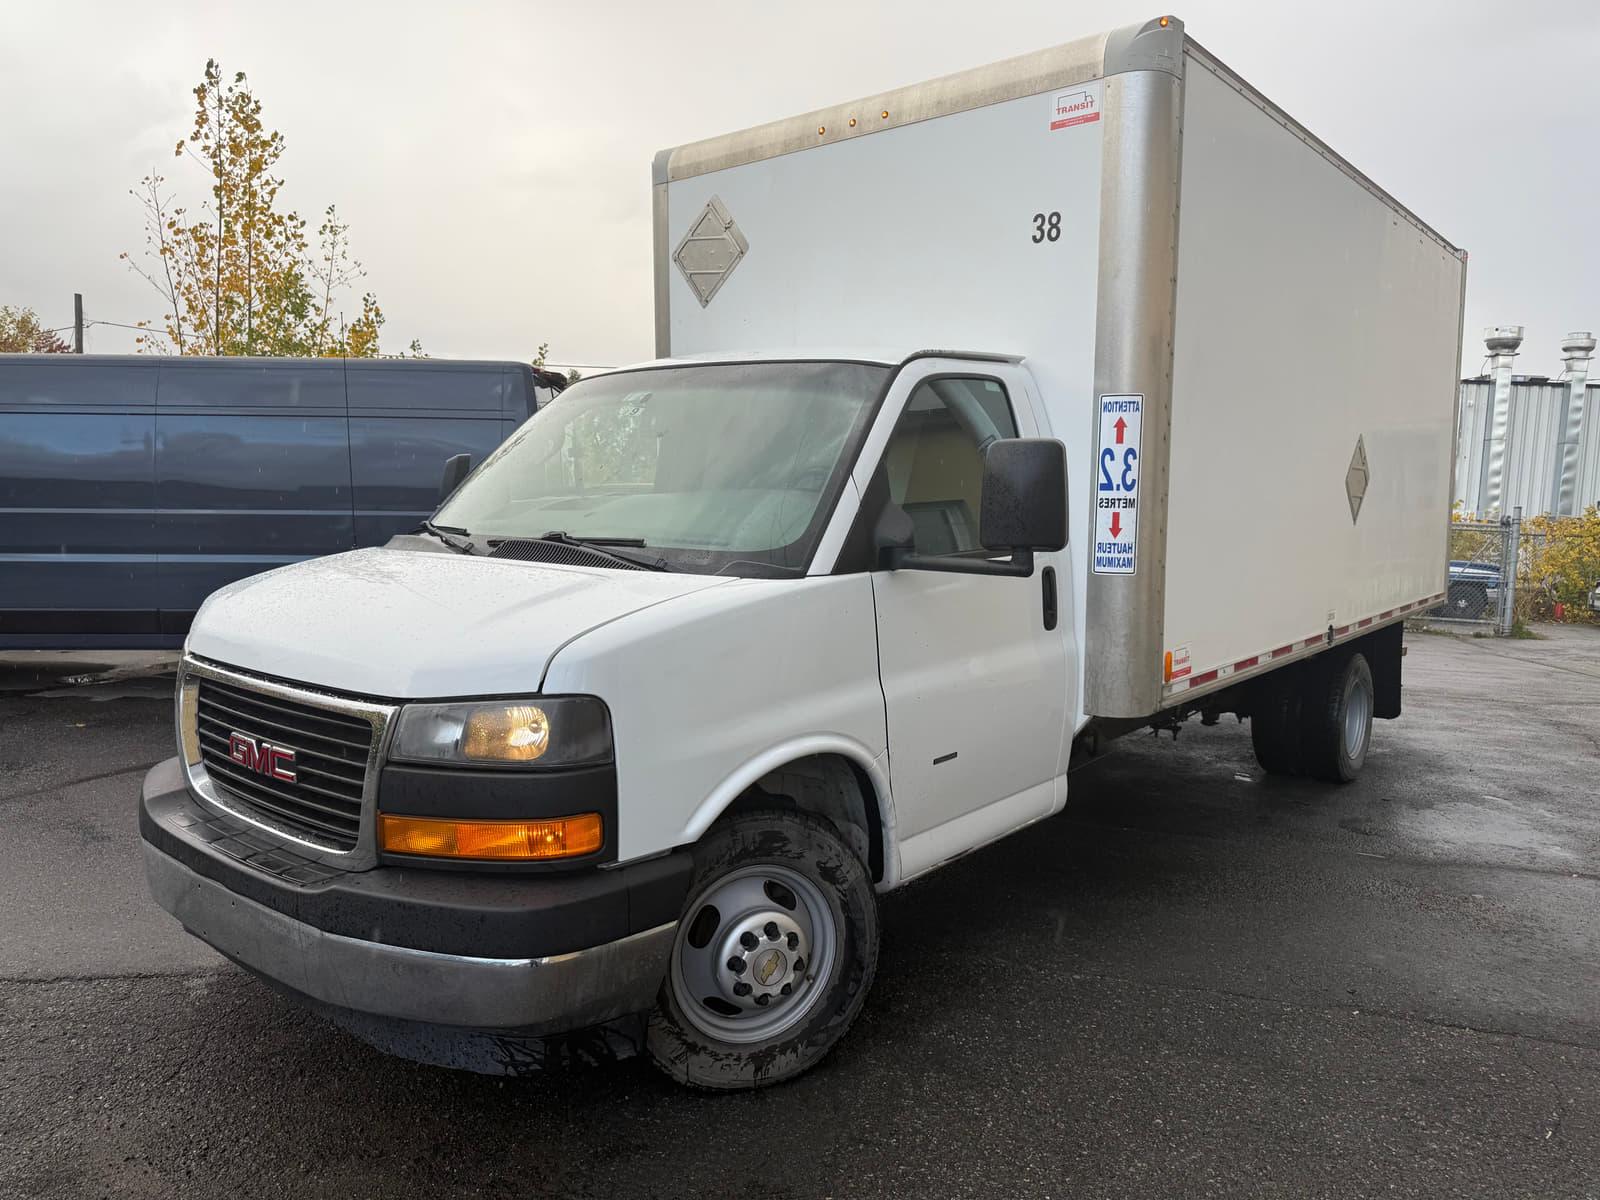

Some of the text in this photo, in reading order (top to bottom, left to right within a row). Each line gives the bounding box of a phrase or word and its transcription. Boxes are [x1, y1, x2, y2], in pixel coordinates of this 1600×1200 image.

[1056, 100, 1095, 115] TRANSIT
[1032, 211, 1061, 244] 38
[229, 731, 297, 783] GMC
